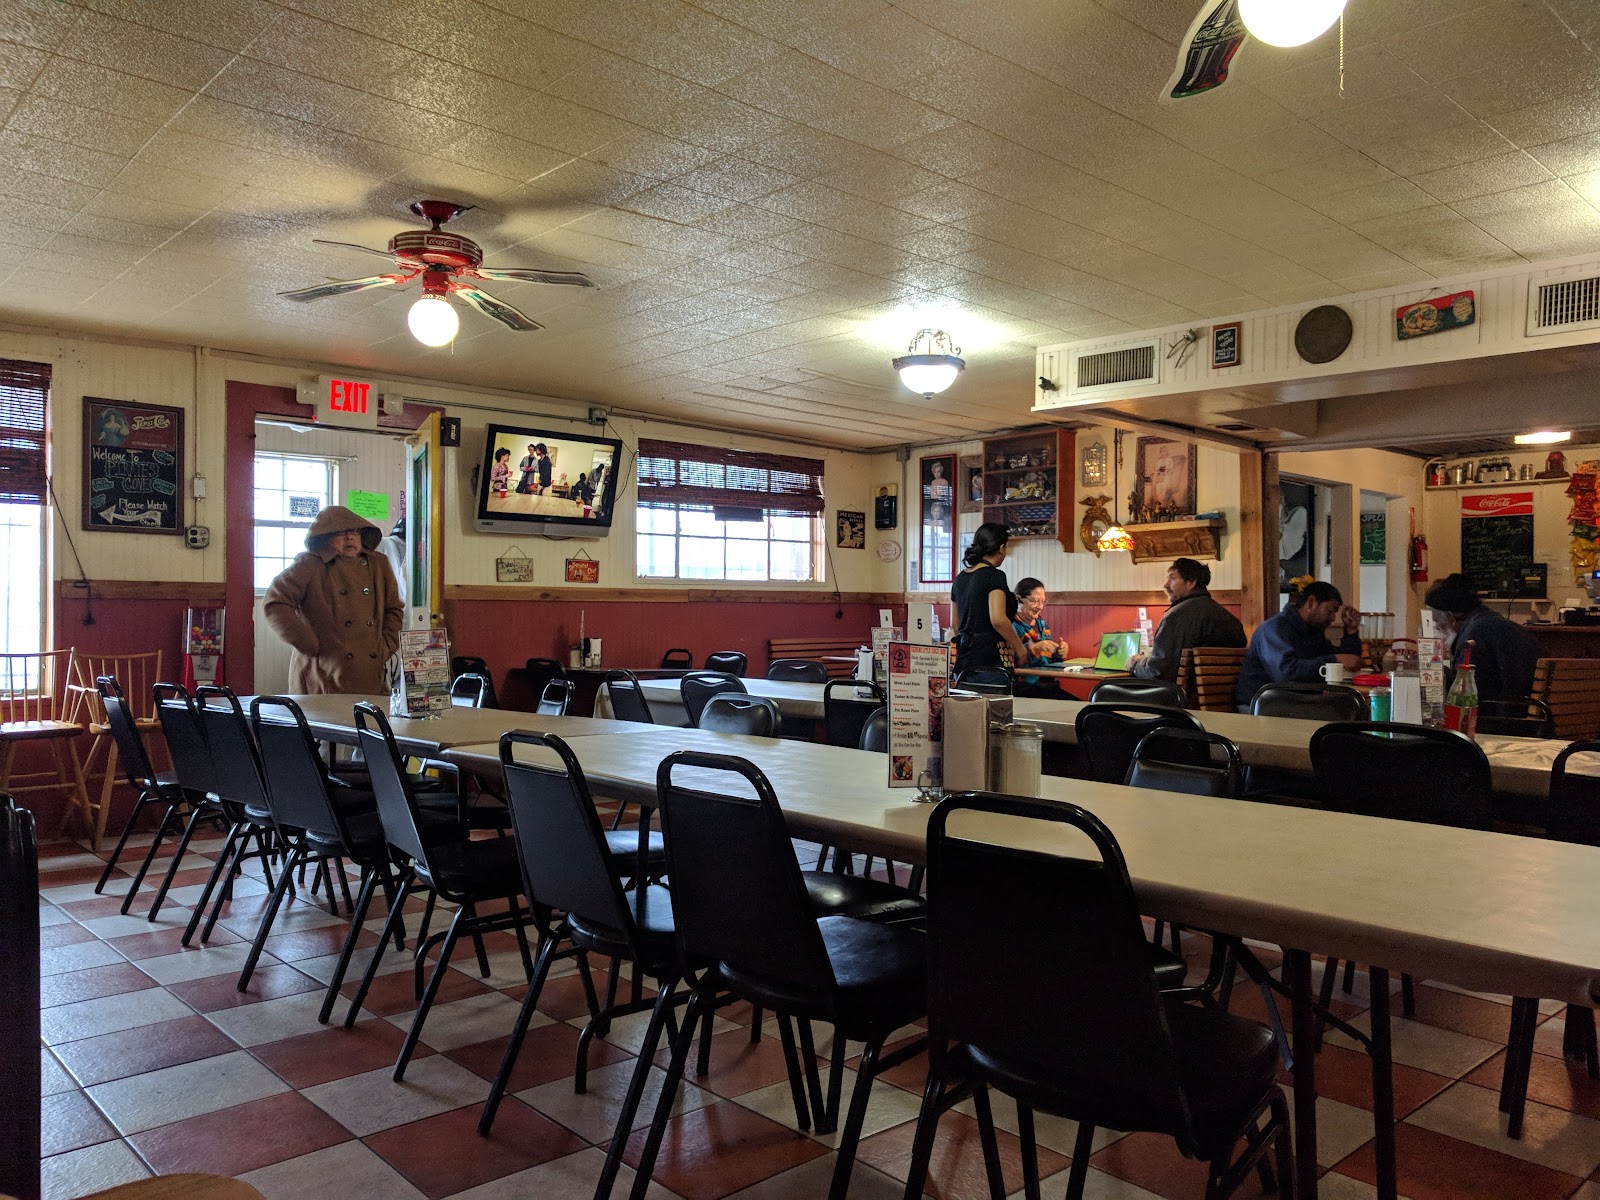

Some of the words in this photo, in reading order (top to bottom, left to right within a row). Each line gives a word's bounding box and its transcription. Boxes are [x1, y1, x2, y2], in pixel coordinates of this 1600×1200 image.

[330, 379, 371, 414] EXIT
[92, 447, 126, 461] Welcome
[126, 449, 143, 465] To
[108, 461, 157, 477] PIRATES
[124, 478, 151, 491] COVE
[119, 498, 145, 511] Please
[147, 500, 168, 511] Watch
[1479, 498, 1511, 508] Coca-Cola
[122, 507, 139, 516] Your
[917, 618, 923, 630] 5
